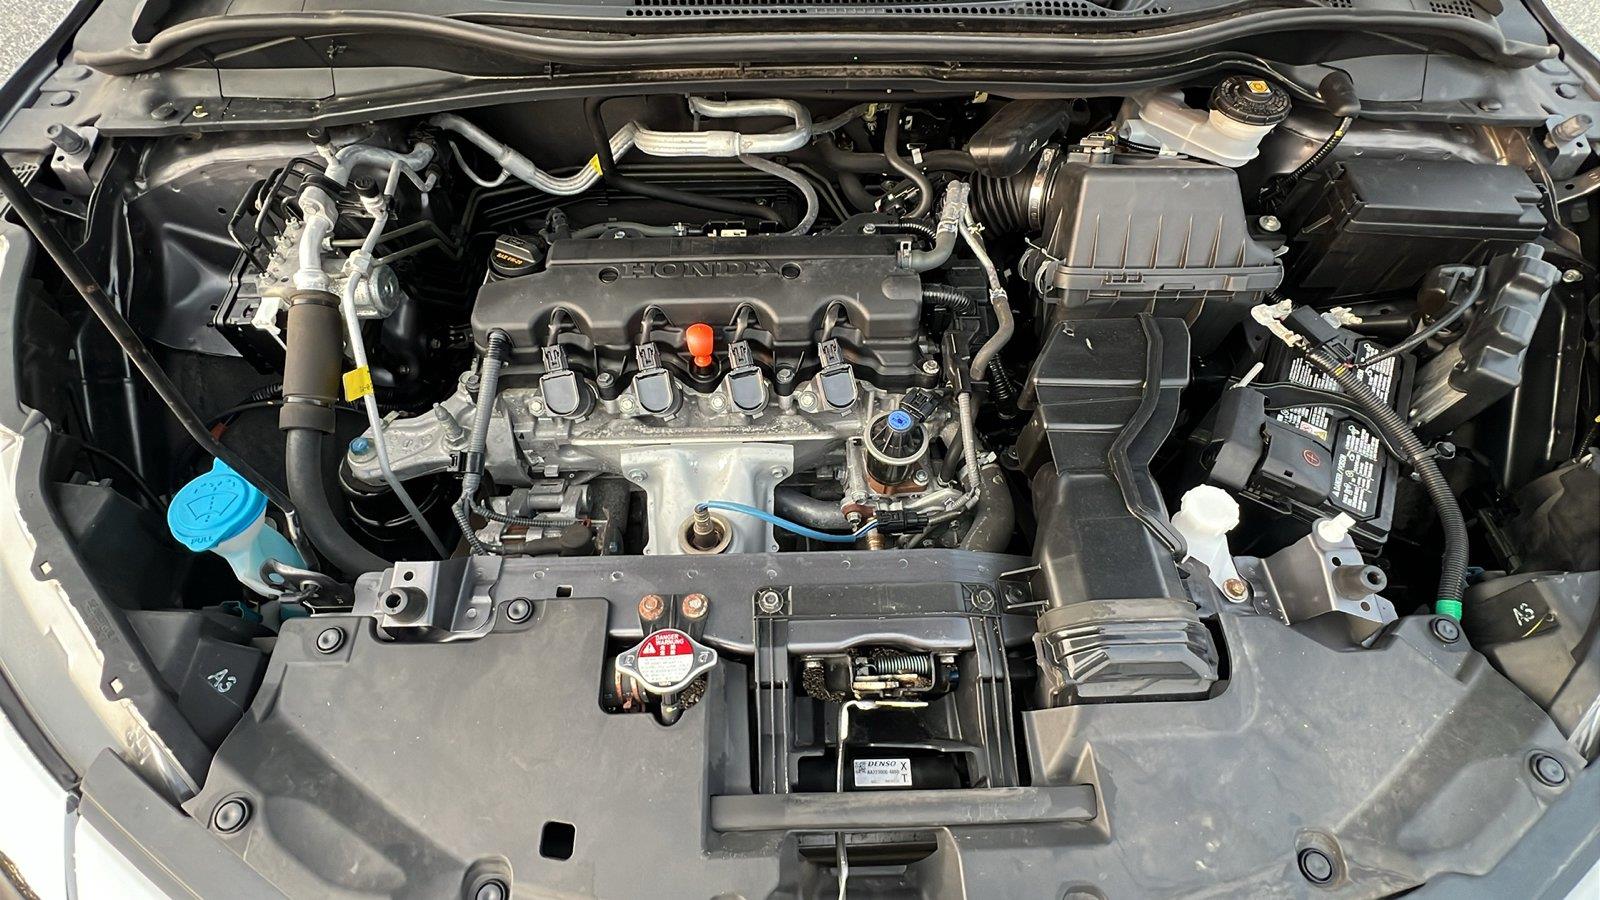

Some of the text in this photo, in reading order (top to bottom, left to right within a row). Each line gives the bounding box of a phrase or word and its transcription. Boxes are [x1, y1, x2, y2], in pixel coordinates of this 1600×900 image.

[621, 260, 780, 279] HONDA
[190, 536, 213, 545] PULL
[655, 633, 679, 641] DANGER
[900, 761, 908, 771] X
[901, 773, 908, 783] T
